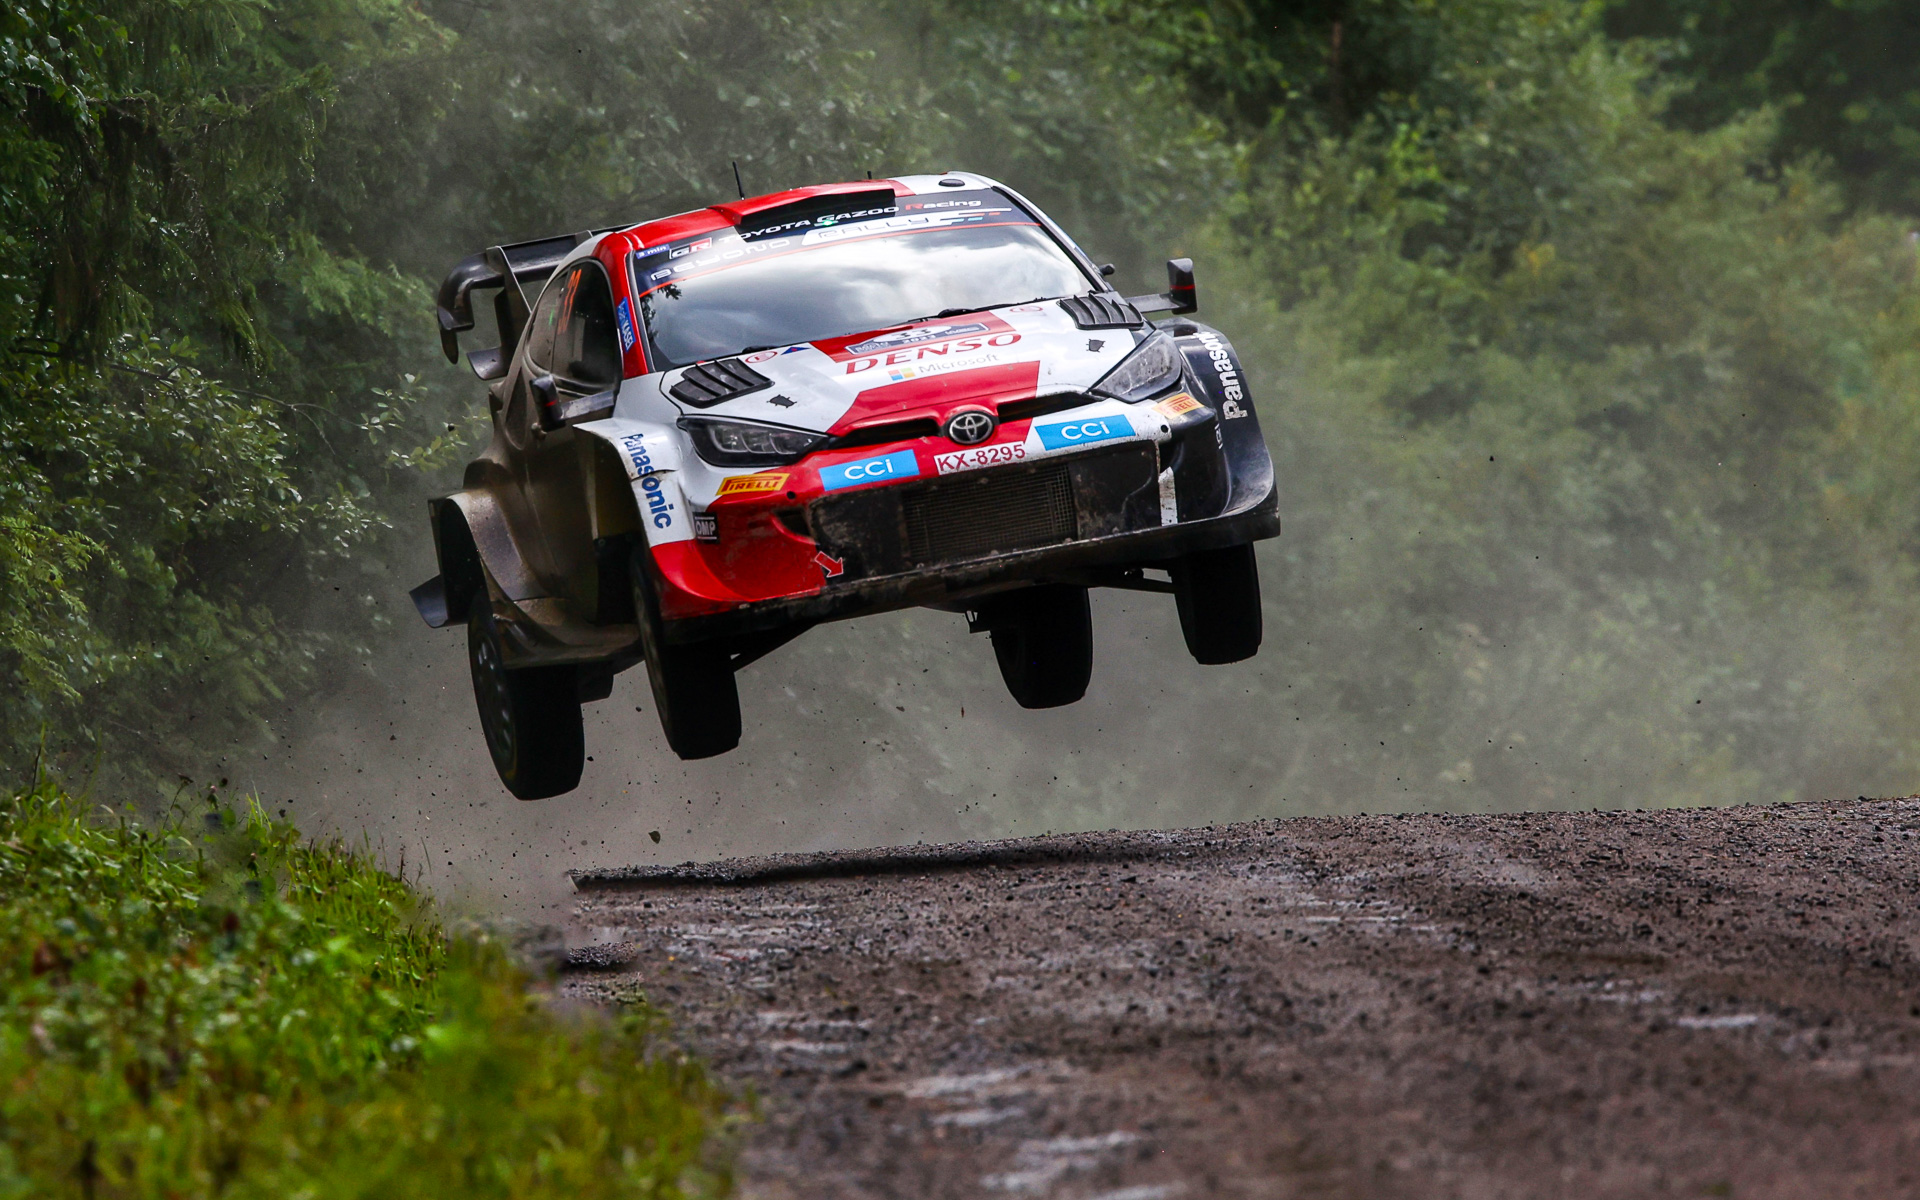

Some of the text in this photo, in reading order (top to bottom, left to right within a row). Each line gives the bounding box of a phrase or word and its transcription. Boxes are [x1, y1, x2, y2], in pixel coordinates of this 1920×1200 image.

[815, 205, 899, 225] GAZOO
[905, 200, 982, 211] Racing
[671, 240, 711, 259] GR
[845, 333, 1022, 375] DENSO
[918, 353, 1000, 374] Microsoft
[937, 444, 1026, 472] KX-8295
[620, 433, 674, 529] Panasonic
[720, 475, 782, 493] PIRELLI
[695, 520, 716, 537] OMP
